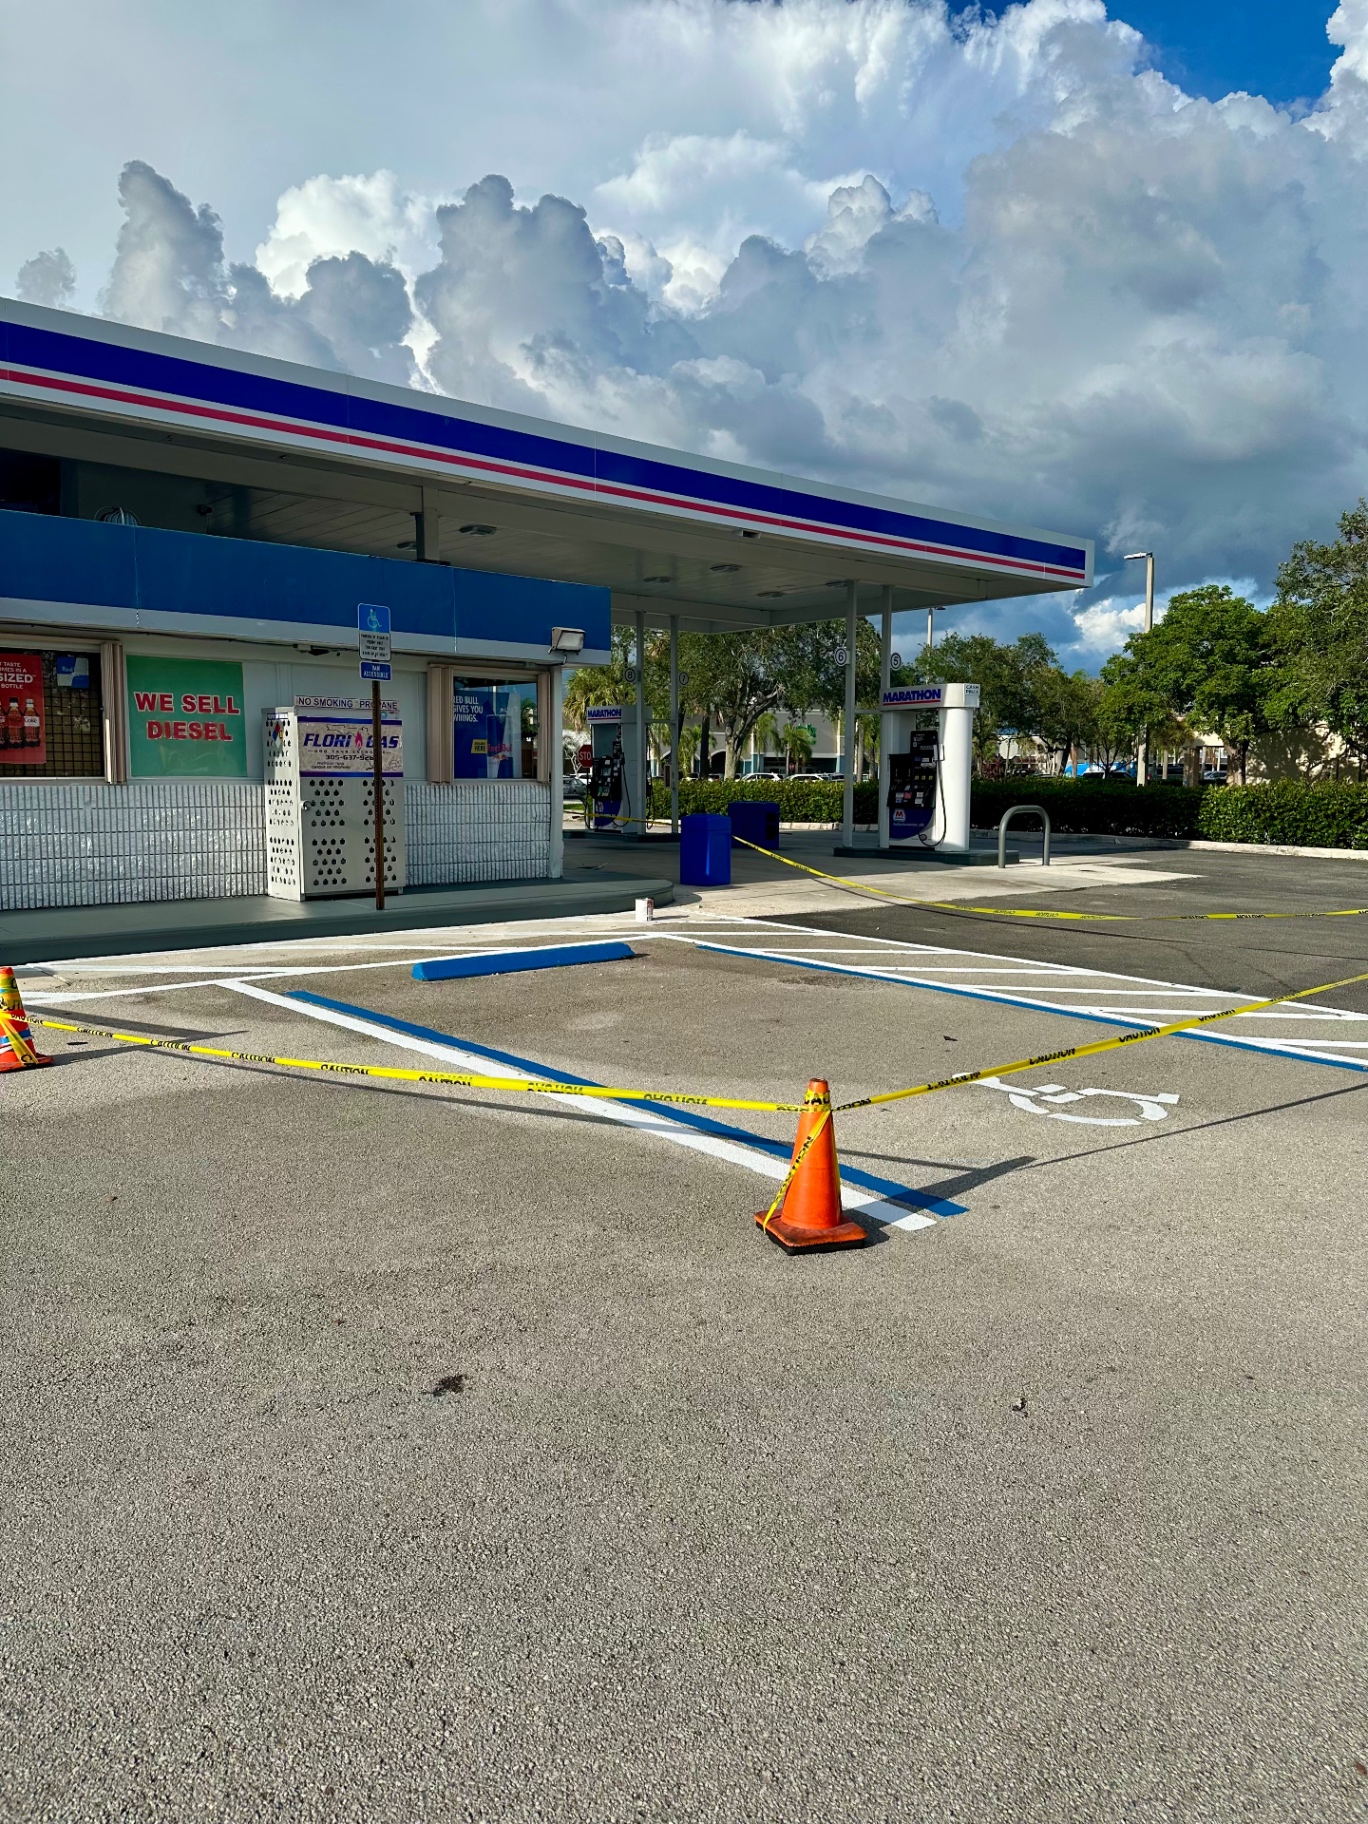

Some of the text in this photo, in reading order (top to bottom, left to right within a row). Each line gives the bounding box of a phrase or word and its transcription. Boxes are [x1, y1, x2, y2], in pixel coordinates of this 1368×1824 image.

[838, 650, 845, 662] 6
[893, 655, 900, 667] 5
[626, 669, 633, 679] 8
[464, 695, 479, 705] BULL
[883, 689, 942, 702] MARATHON
[133, 691, 240, 715] WE SELL
[298, 697, 398, 710] NO SMOKING PRANE
[453, 704, 484, 714] GIVES YOU
[587, 709, 621, 718] MARATHON
[146, 720, 233, 741] DIESEL
[302, 732, 353, 748] FLORI
[579, 751, 592, 761] STO
